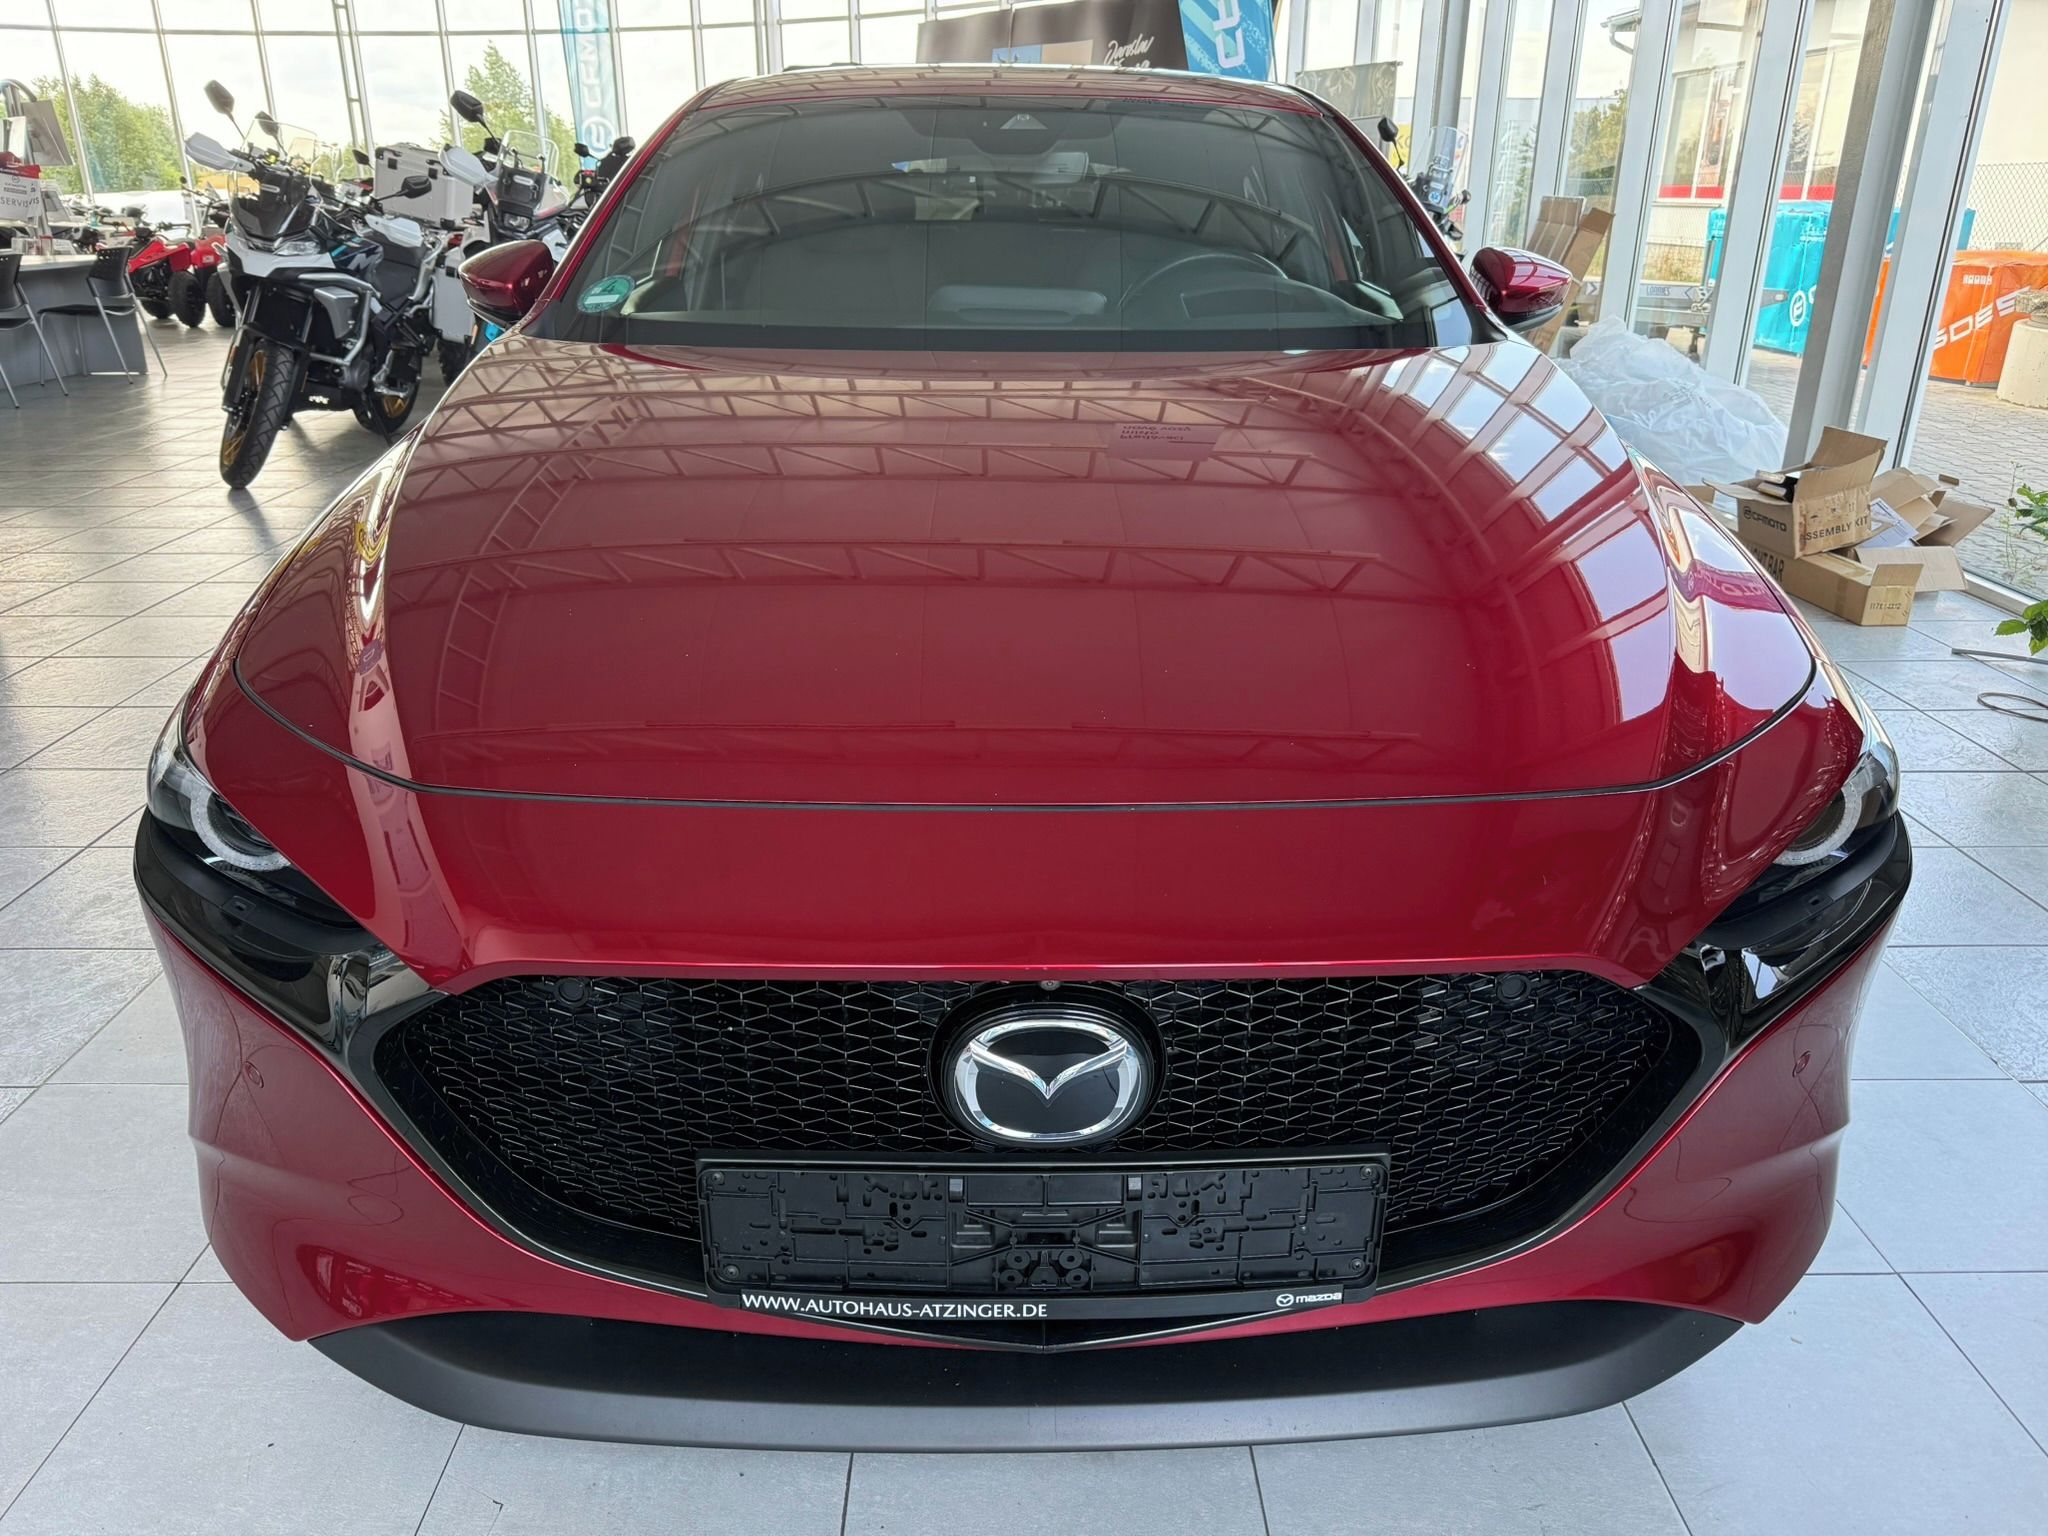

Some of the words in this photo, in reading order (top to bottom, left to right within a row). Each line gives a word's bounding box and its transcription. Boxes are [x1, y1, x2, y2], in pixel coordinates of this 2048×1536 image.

[1805, 521, 1852, 541] SSEMBLY
[1854, 515, 1868, 527] KIT
[742, 1293, 1047, 1318] WWW.AUTOHAUS-ATZINGER.DE
